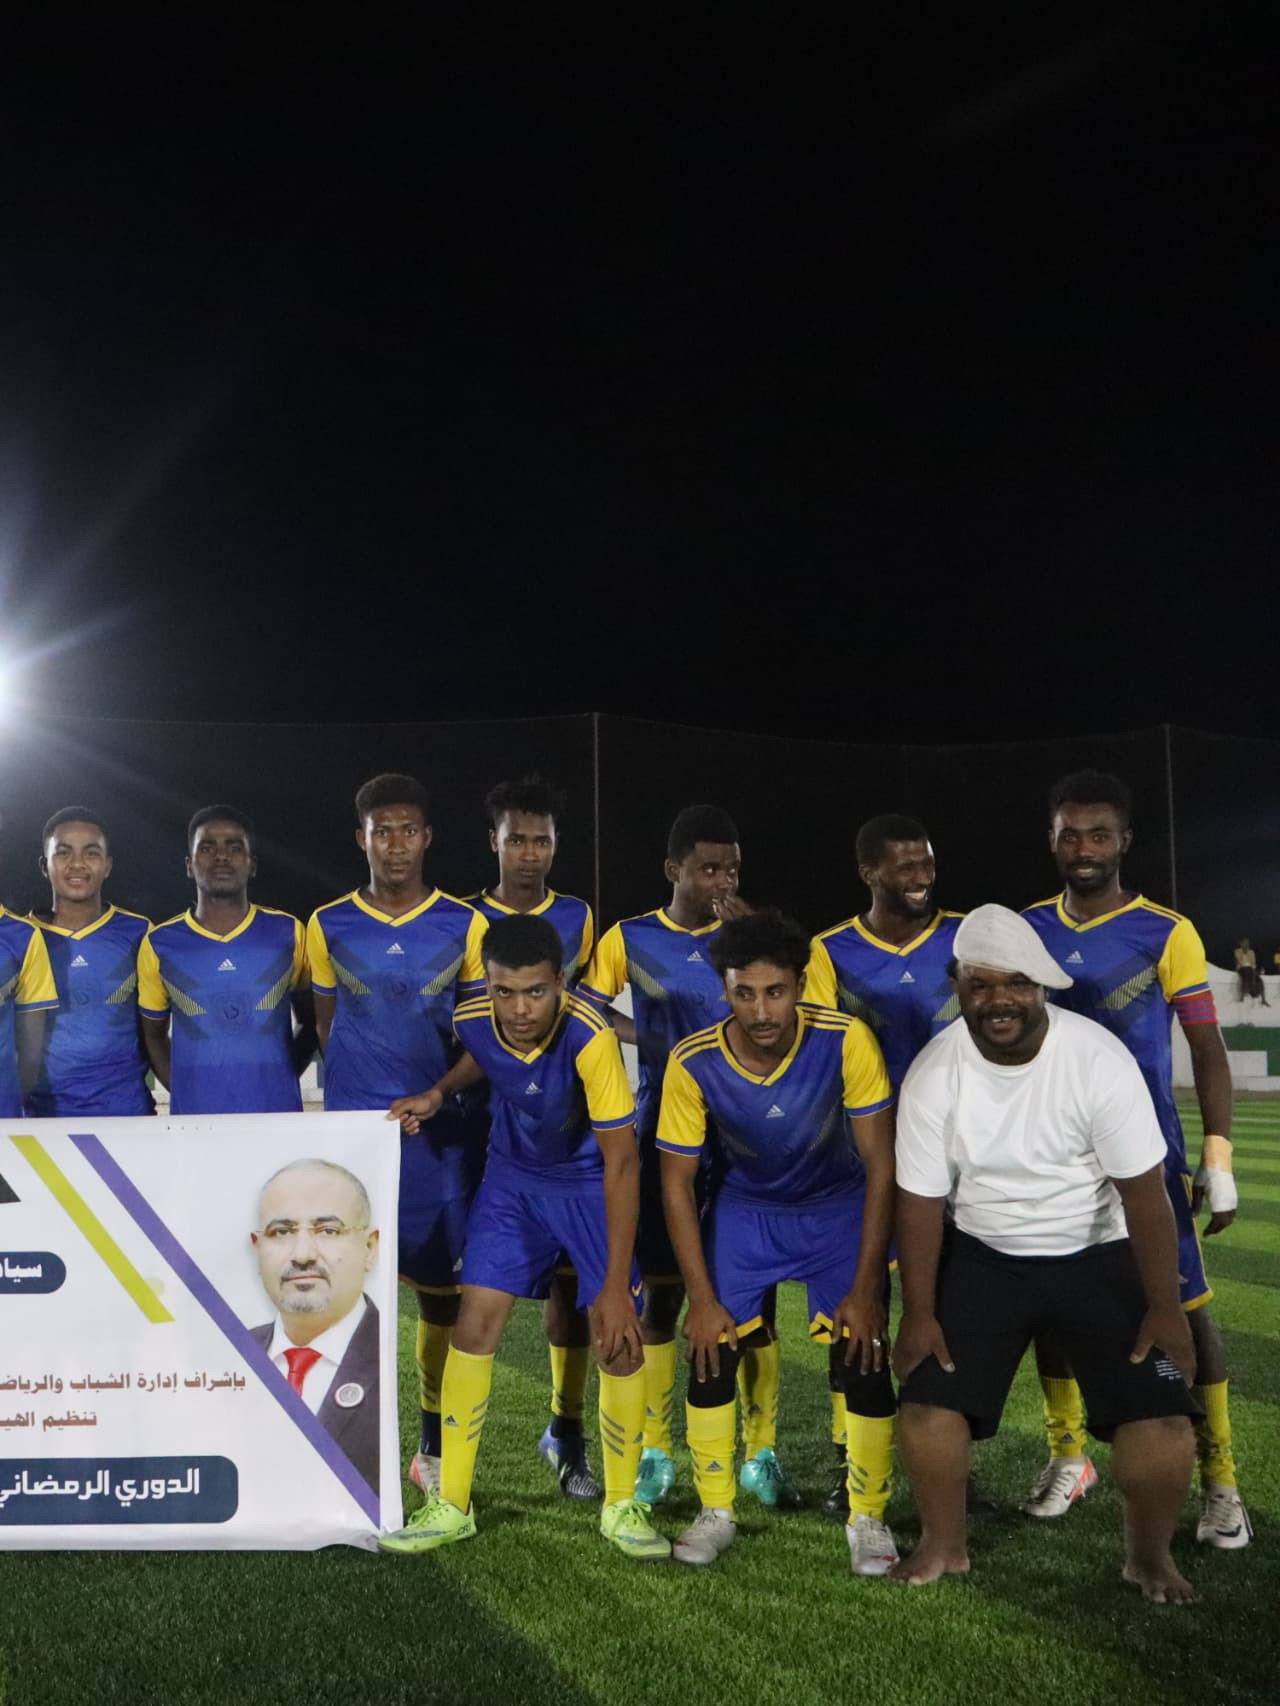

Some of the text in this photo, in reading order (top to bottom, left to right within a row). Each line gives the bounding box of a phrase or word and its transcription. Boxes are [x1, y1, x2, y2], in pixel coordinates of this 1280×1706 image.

[69, 1371, 131, 1394] الشباب
[136, 1371, 178, 1393] إدارة
[183, 1370, 247, 1393] بإشراف
[41, 1409, 98, 1433] تنظيم
[114, 1467, 200, 1508] الدوري
